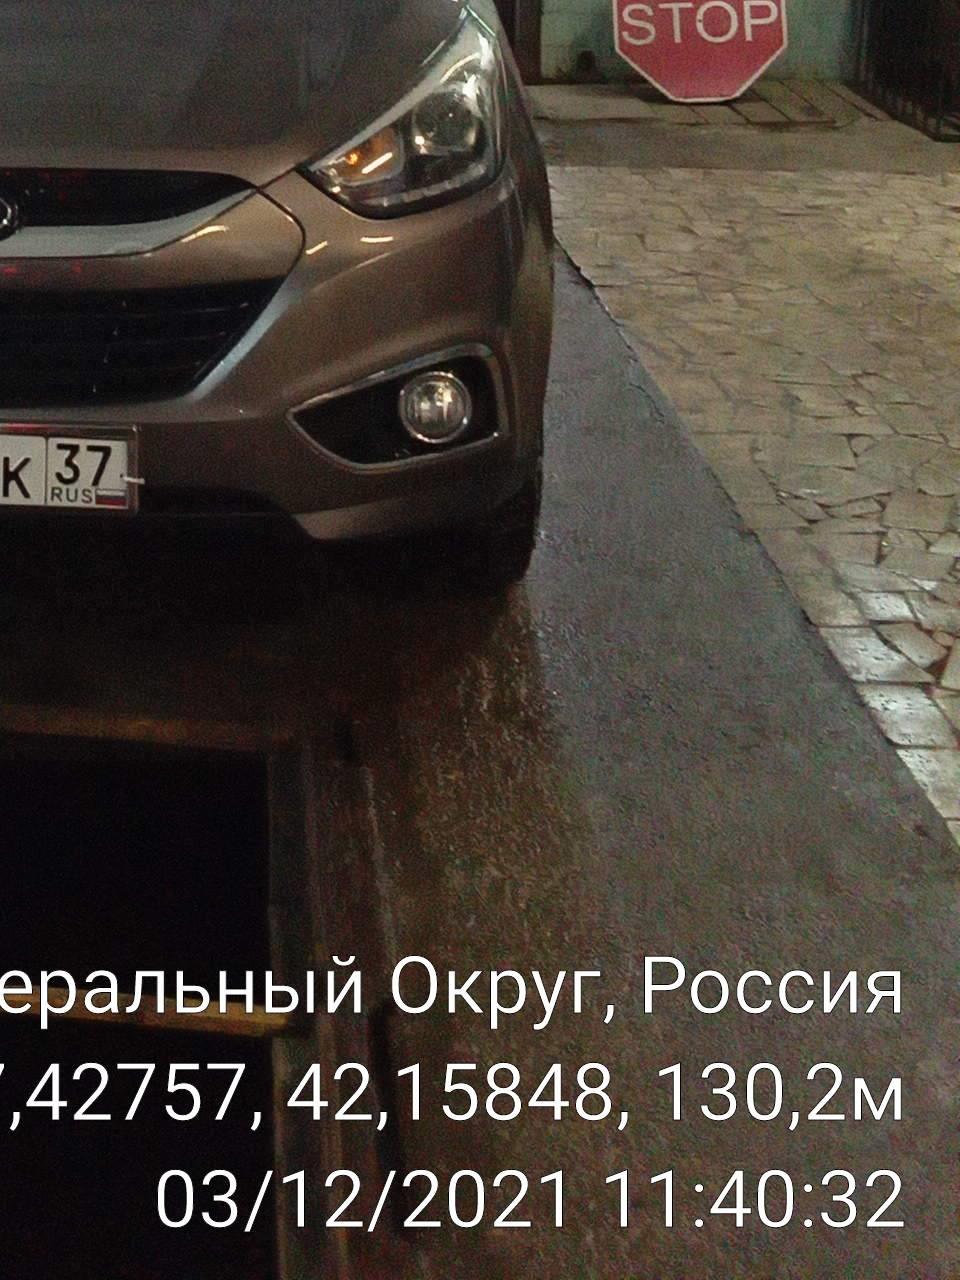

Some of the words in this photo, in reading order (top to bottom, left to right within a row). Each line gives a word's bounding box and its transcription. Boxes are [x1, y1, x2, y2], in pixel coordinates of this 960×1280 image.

[621, 0, 779, 46] STOP
[54, 442, 113, 488] 37
[49, 486, 93, 505] RUS
